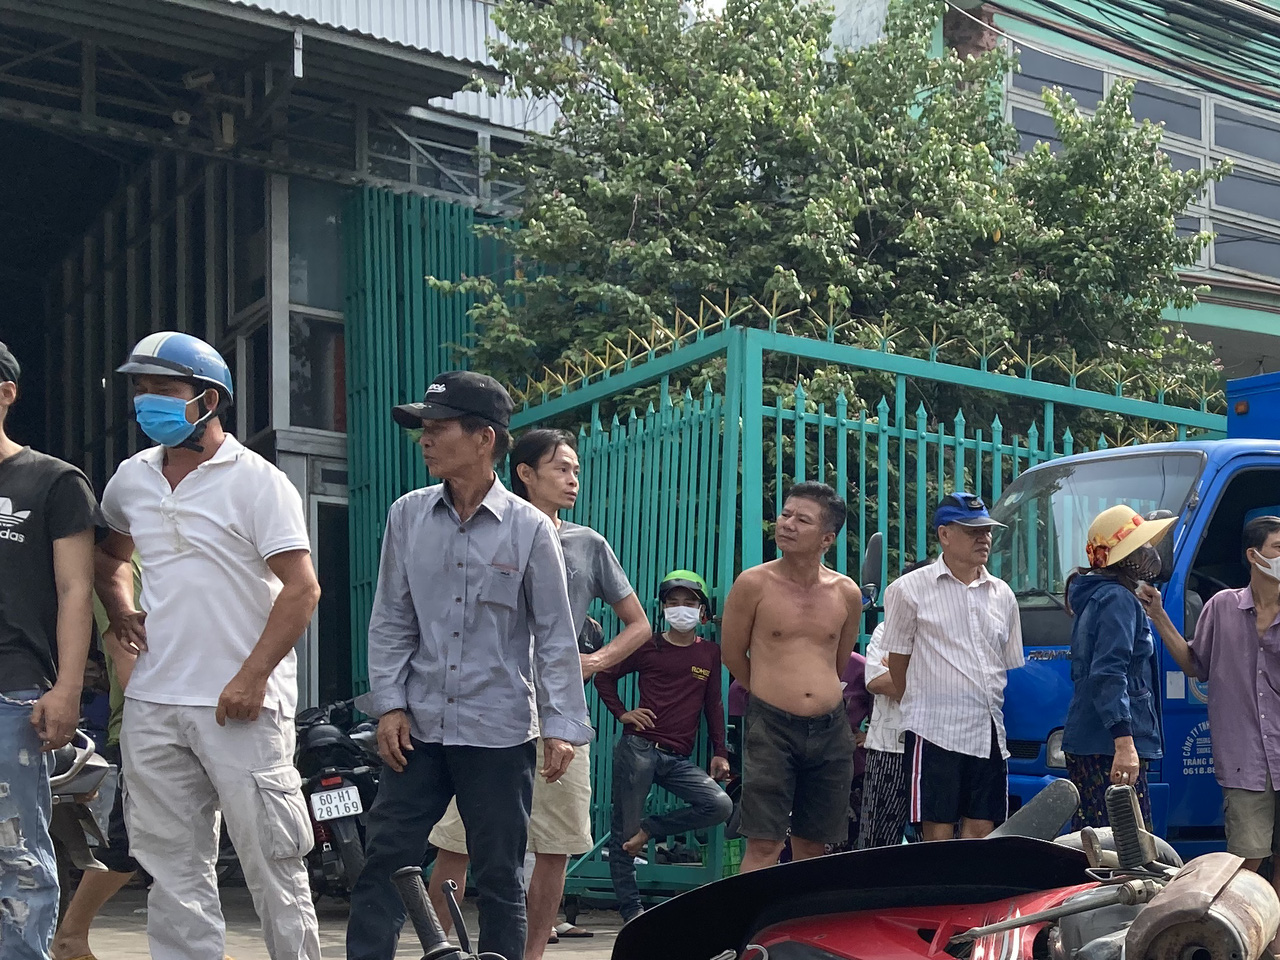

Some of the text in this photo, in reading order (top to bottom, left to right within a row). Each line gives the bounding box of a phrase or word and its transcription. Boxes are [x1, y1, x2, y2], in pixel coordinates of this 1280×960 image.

[1182, 735, 1195, 757] CÔNG
[1190, 726, 1200, 738] TY
[319, 790, 351, 806] 60-H1
[317, 801, 359, 819] 281.69
